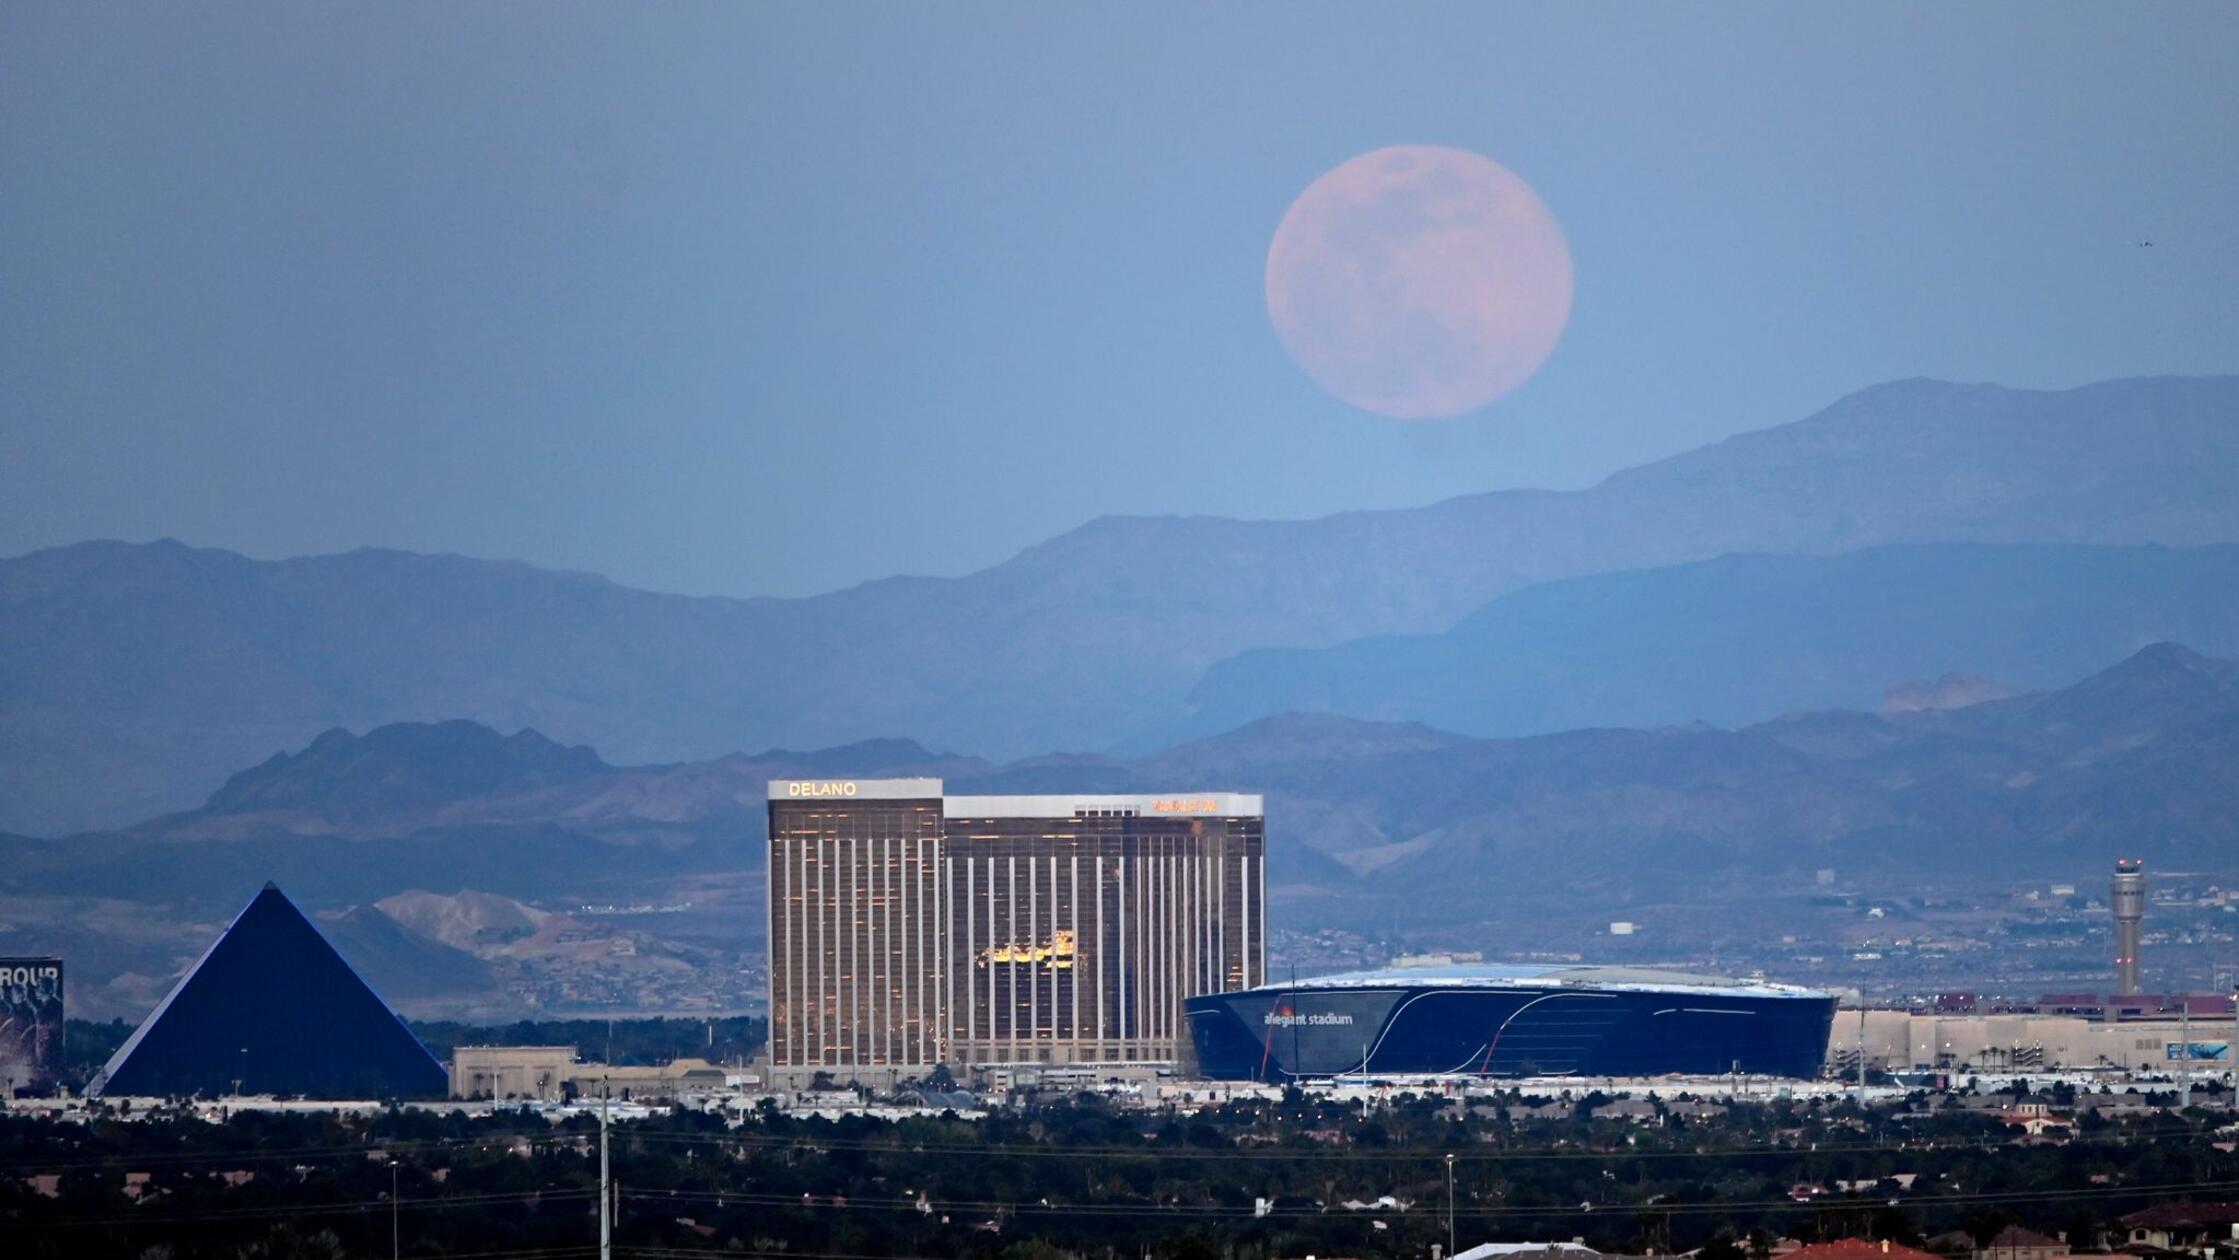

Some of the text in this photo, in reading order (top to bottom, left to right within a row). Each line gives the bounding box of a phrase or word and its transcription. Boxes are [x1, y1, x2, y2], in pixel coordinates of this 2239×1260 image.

[789, 783, 856, 796] DELANO
[1264, 1012, 1353, 1028] allegiant stadium
